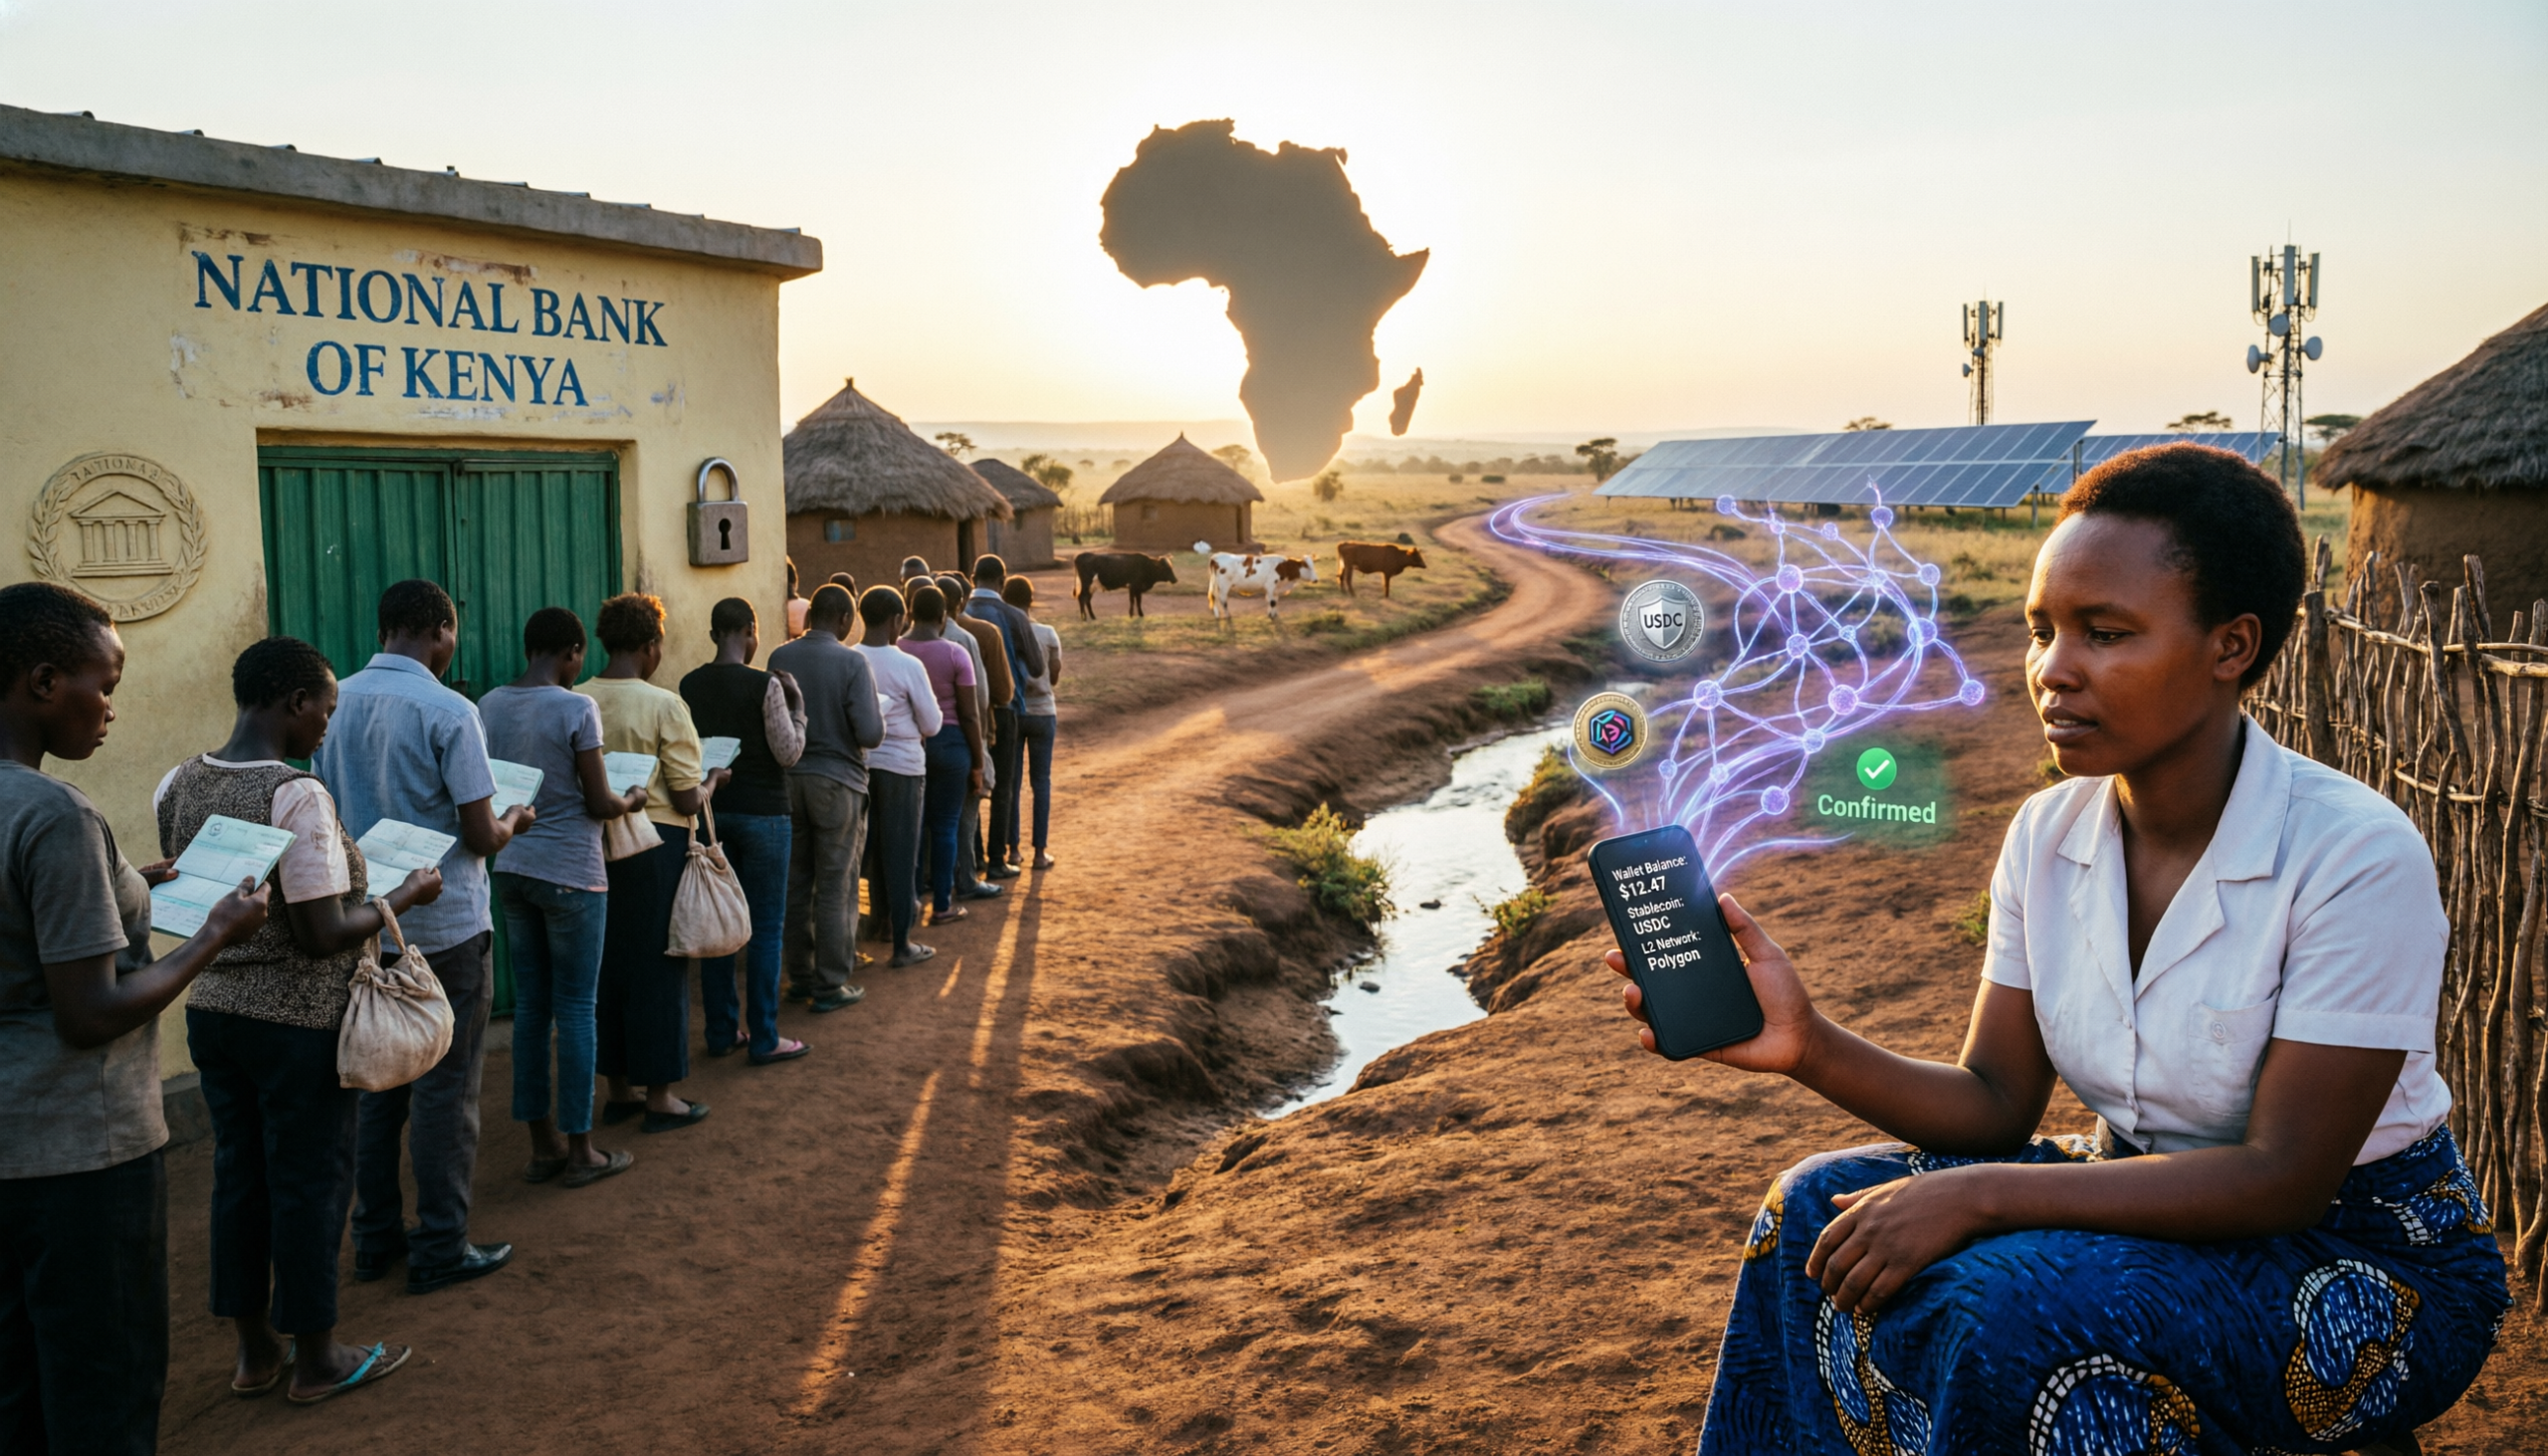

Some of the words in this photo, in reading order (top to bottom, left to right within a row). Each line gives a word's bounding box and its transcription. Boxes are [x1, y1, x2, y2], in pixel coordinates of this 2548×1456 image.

[191, 250, 520, 332] NATIONAL
[531, 288, 668, 346] BANK
[307, 340, 386, 395] OF
[401, 346, 589, 406] KENYA
[1643, 613, 1683, 629] USDC
[1612, 865, 1644, 882] Wallet
[1645, 856, 1688, 874] Balance:
[1619, 876, 1666, 902] $12.47
[1627, 898, 1684, 919] Stablecoin:
[1633, 916, 1671, 935] USDC
[1641, 940, 1656, 955] L2
[1656, 932, 1702, 950] Network:
[1647, 948, 1702, 971] Polygon
